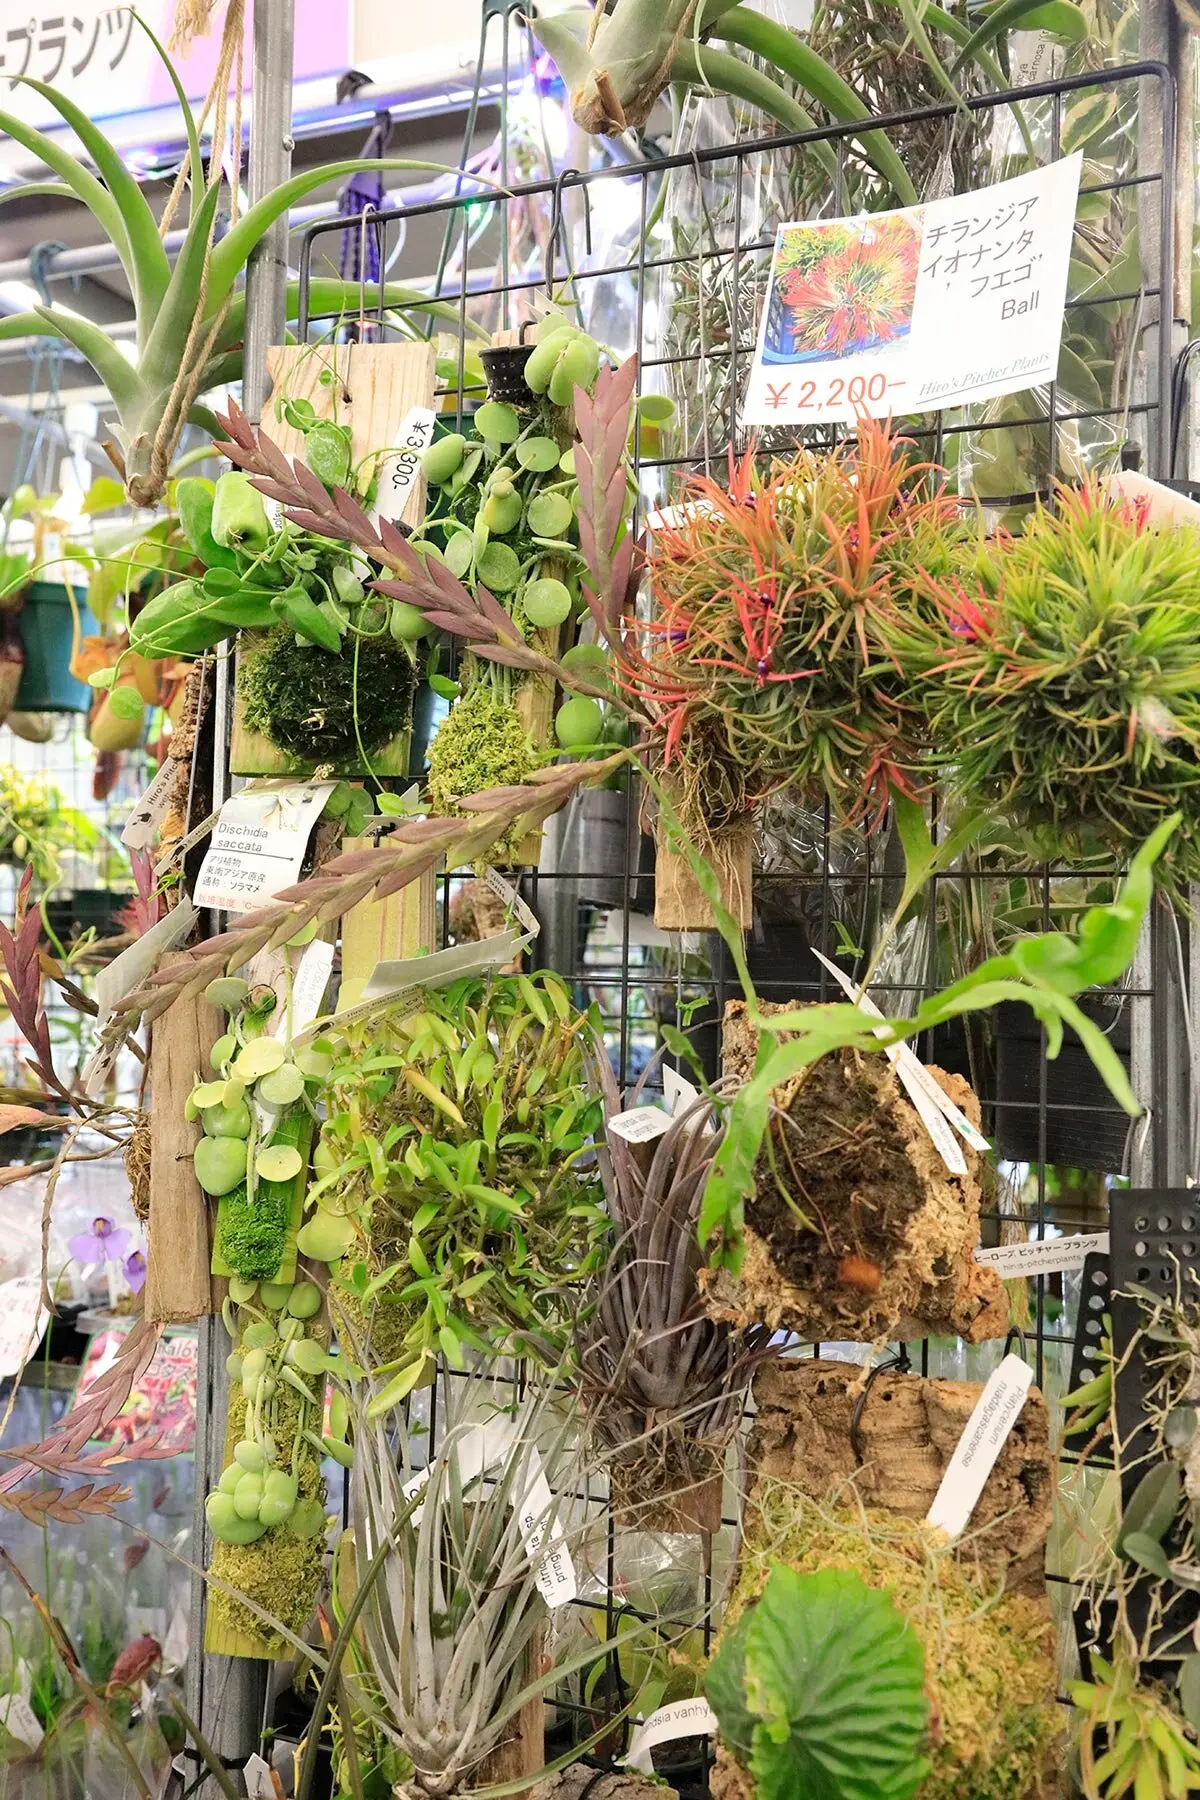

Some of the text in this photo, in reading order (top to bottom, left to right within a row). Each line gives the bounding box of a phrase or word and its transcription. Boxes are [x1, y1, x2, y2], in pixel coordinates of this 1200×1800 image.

[926, 196, 1039, 248] チランジア
[922, 229, 1035, 278] イオナンタ
[1001, 290, 1040, 320] Ball
[919, 352, 1050, 397] Hiro's Pitcher Plants
[217, 838, 263, 852] saccata
[218, 823, 269, 839] Dischidia
